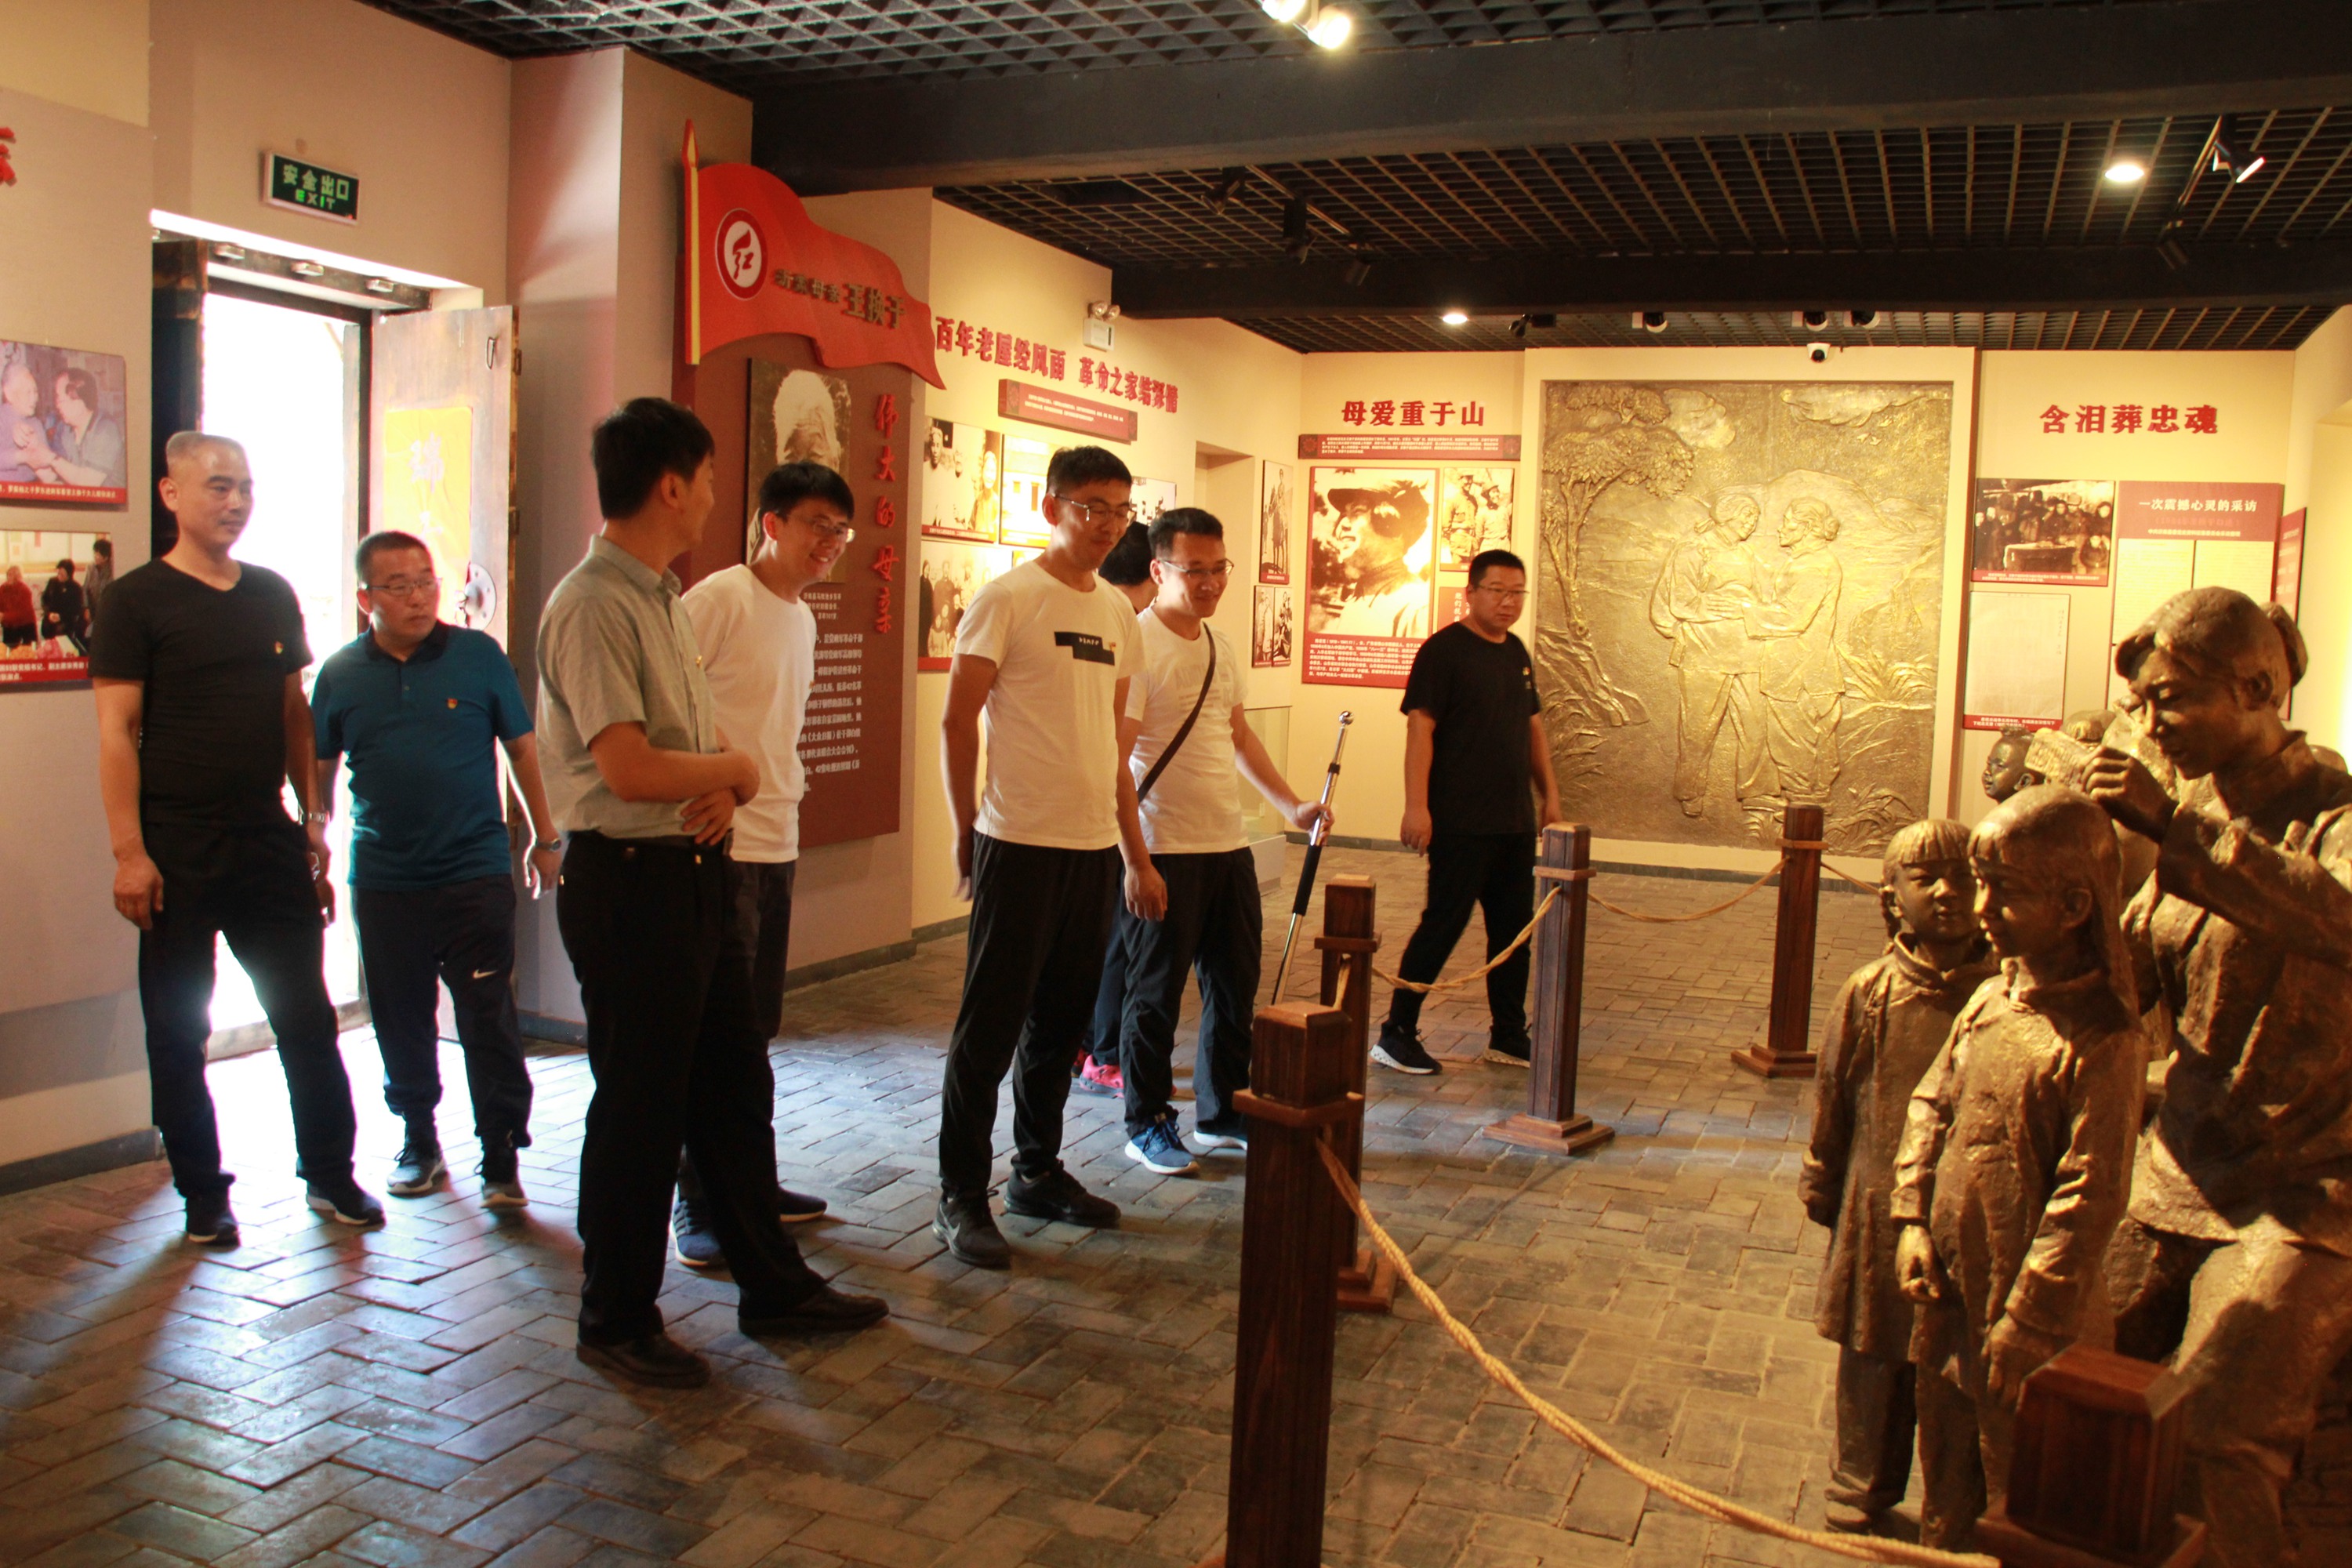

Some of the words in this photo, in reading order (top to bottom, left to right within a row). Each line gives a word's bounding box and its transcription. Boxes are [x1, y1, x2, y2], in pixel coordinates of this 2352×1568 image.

[283, 164, 350, 201] 安全出口
[295, 189, 336, 210] EXIT
[935, 316, 1066, 381] 百年老屋经风雨
[1079, 357, 1179, 413] 革命之家结深情
[1341, 400, 1484, 426] 母爱重于山
[2039, 405, 2218, 434] 含泪葬忠魂
[871, 394, 899, 633] 伟大的母亲
[2139, 499, 2257, 512] 一次震撼心灵的采访
